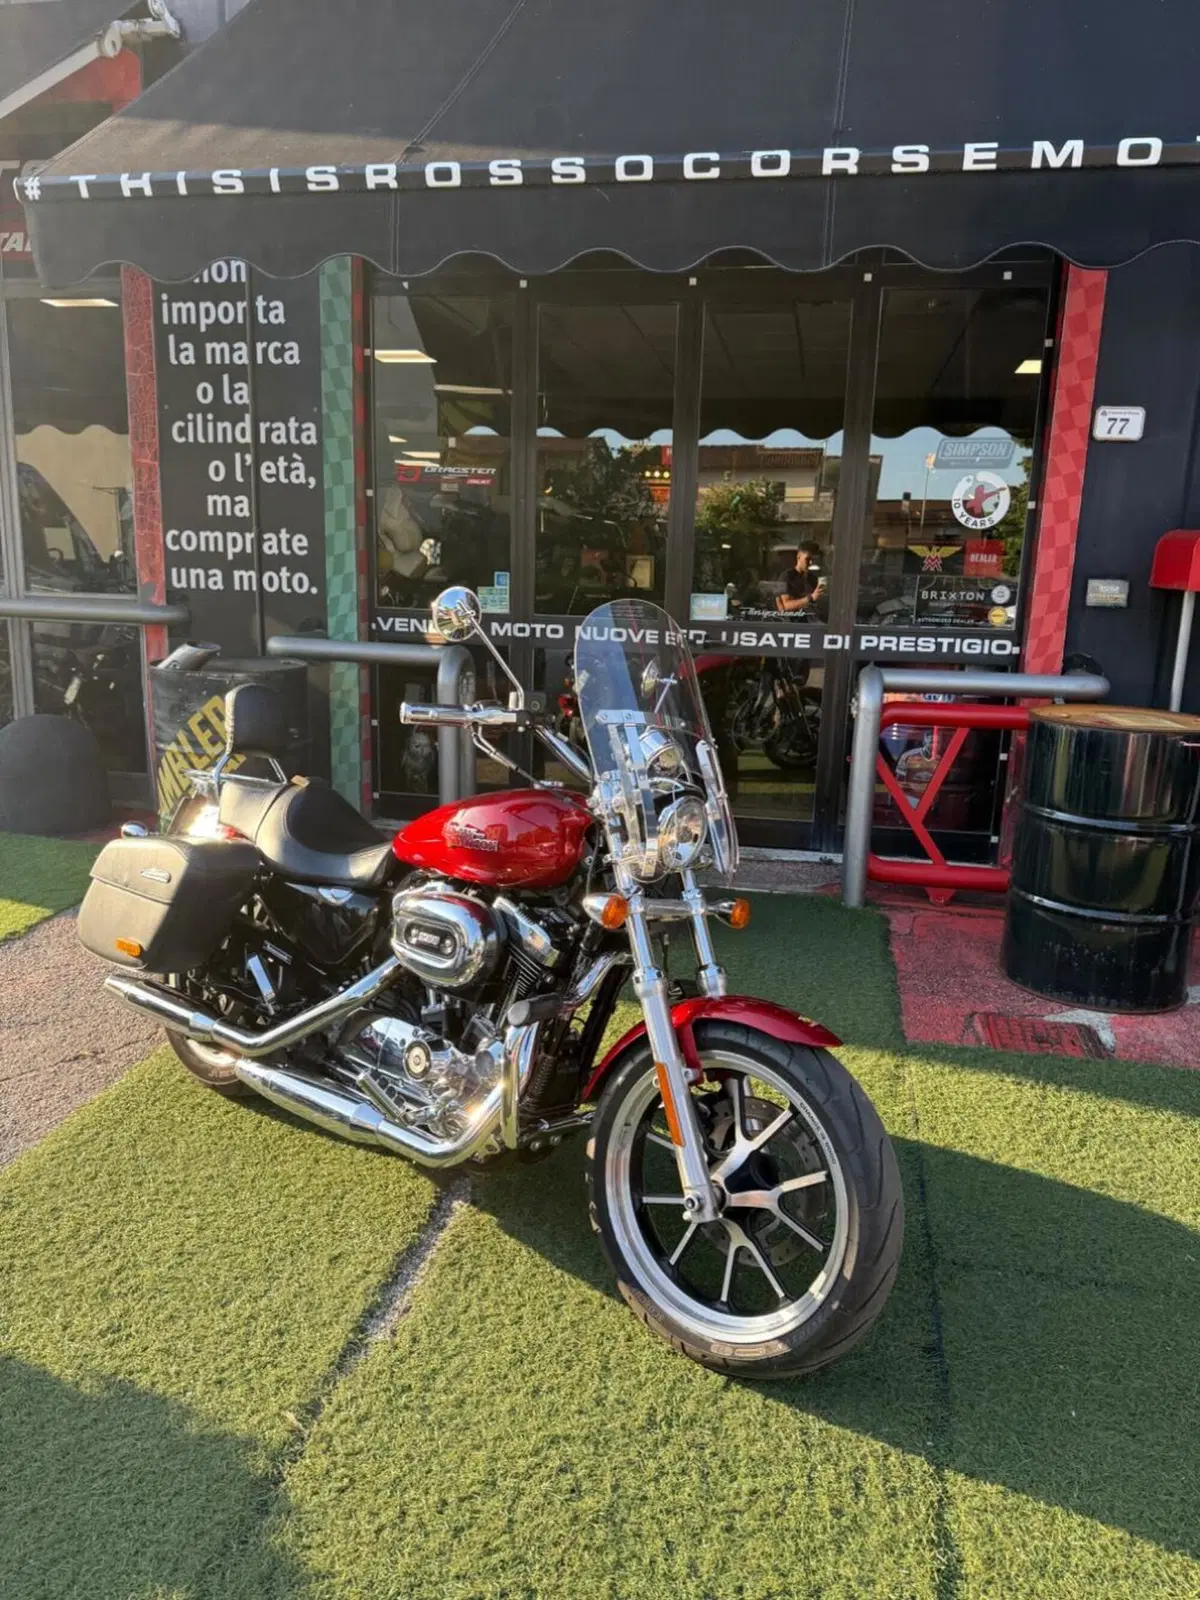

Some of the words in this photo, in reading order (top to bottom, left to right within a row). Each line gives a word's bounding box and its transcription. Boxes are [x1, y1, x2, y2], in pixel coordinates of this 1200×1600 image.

[161, 293, 286, 331] importa
[168, 334, 196, 365] la
[205, 341, 301, 365] marca
[196, 381, 214, 404] o
[222, 373, 250, 404] la
[171, 413, 318, 445] cilindrata
[1107, 417, 1130, 435] 77
[944, 442, 1008, 458] SIMPSON
[208, 460, 226, 482] o
[207, 494, 251, 518] ma
[959, 511, 996, 528] YEARS
[165, 529, 309, 560] comprate
[171, 566, 224, 590] una
[233, 568, 318, 595] moto.
[921, 590, 985, 602] BRIXTON
[491, 621, 564, 639] MOTO
[574, 625, 660, 644] NUOVE
[721, 631, 811, 649] USATE
[823, 634, 850, 650] DI
